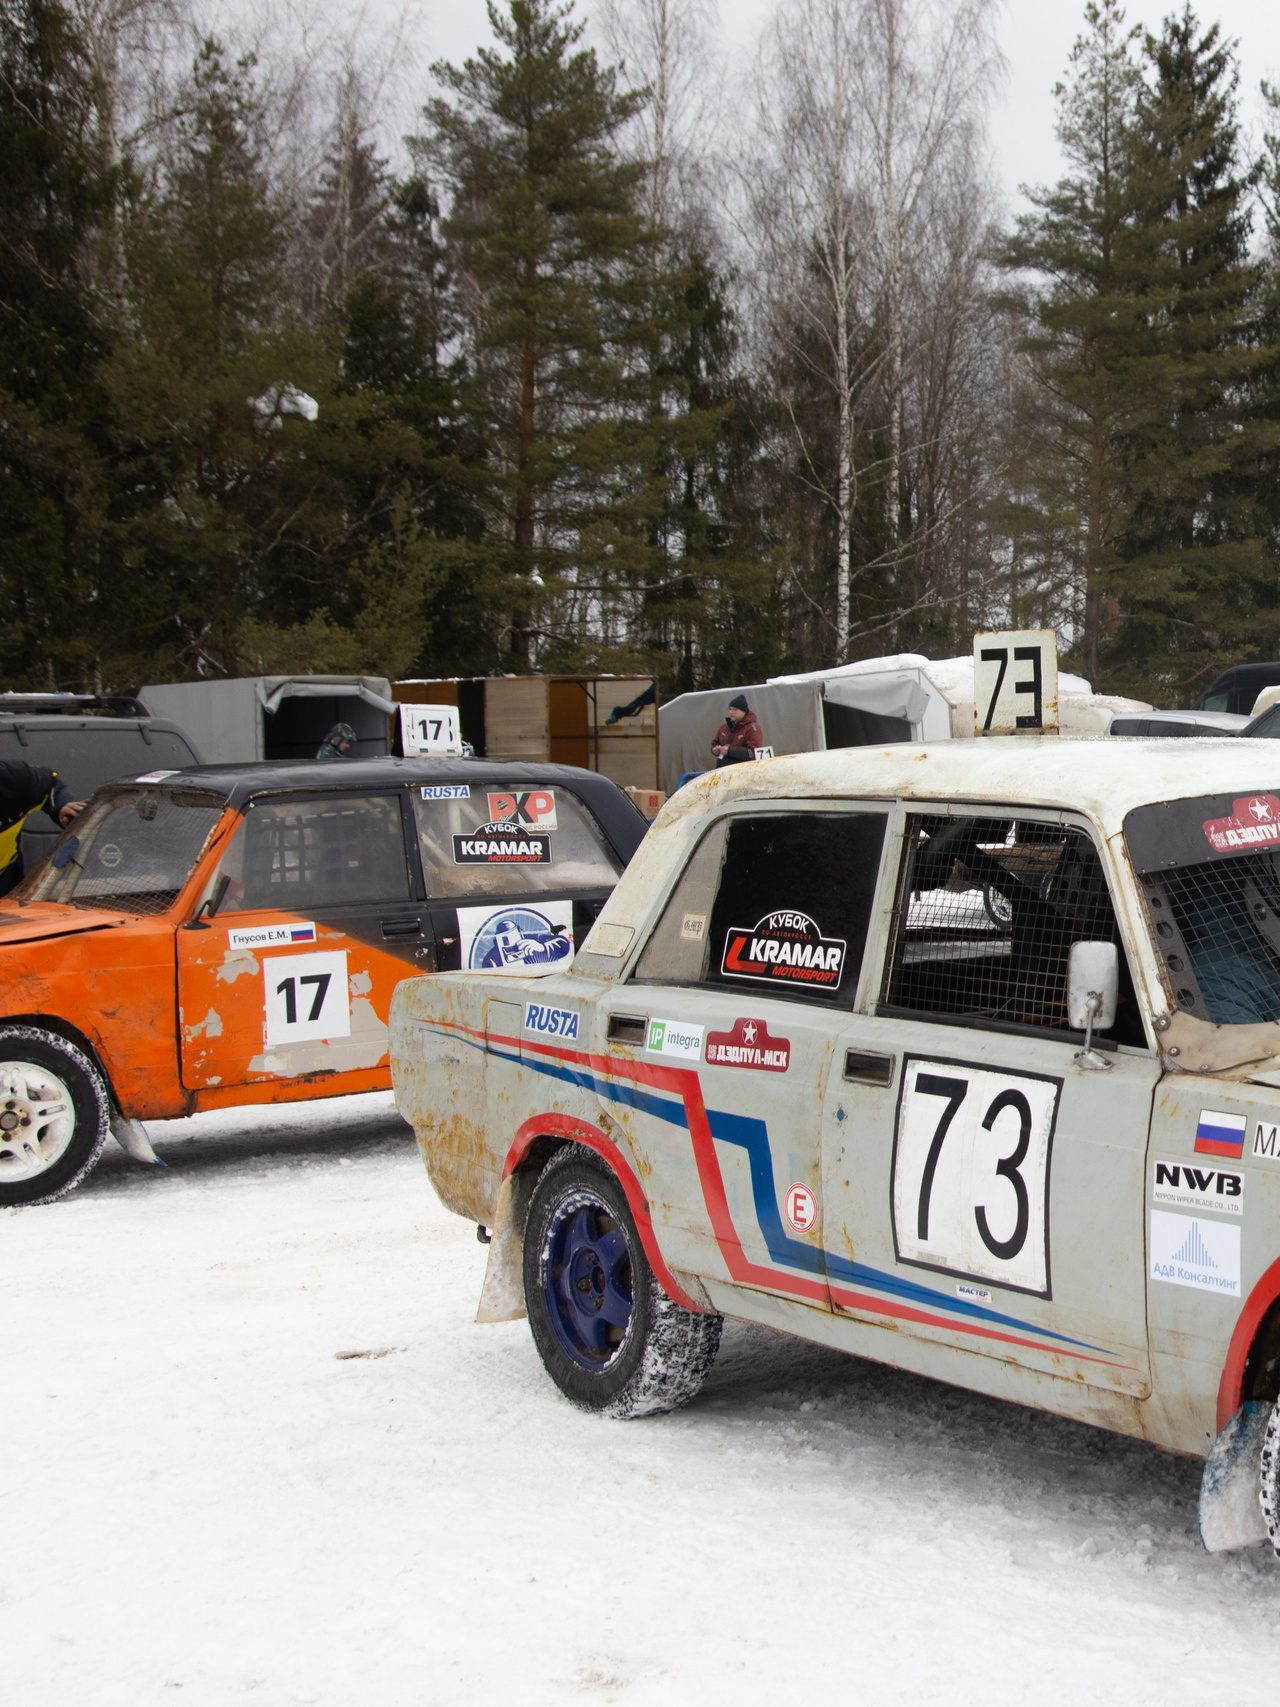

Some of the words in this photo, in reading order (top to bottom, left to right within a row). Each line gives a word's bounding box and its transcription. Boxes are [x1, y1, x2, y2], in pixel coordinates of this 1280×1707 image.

[981, 646, 1042, 731] 73
[418, 719, 442, 740] 17
[423, 786, 469, 798] RUSTA
[484, 823, 519, 834] КУБОК
[461, 841, 542, 855] KRAMAR
[769, 913, 810, 934] КУБОК
[233, 934, 266, 944] Гнусов
[749, 938, 841, 971] KRAMAR
[771, 965, 838, 983] MOTORSPORT
[277, 973, 332, 1023] 17
[526, 1005, 579, 1038] RUSTA
[667, 1030, 700, 1049] integra
[716, 1044, 787, 1067] ДЭДПУЛ-МСК
[915, 1072, 1032, 1260] 73
[1156, 1163, 1241, 1196] NWB
[794, 1192, 806, 1223] E
[1155, 1192, 1175, 1201] NIPPON
[1176, 1195, 1194, 1204] WIPER
[1195, 1198, 1213, 1207] BLADE
[1153, 1262, 1175, 1278] АДВ
[1177, 1268, 1238, 1291] Консалтинг
[959, 1286, 988, 1297] МАСТЕР
